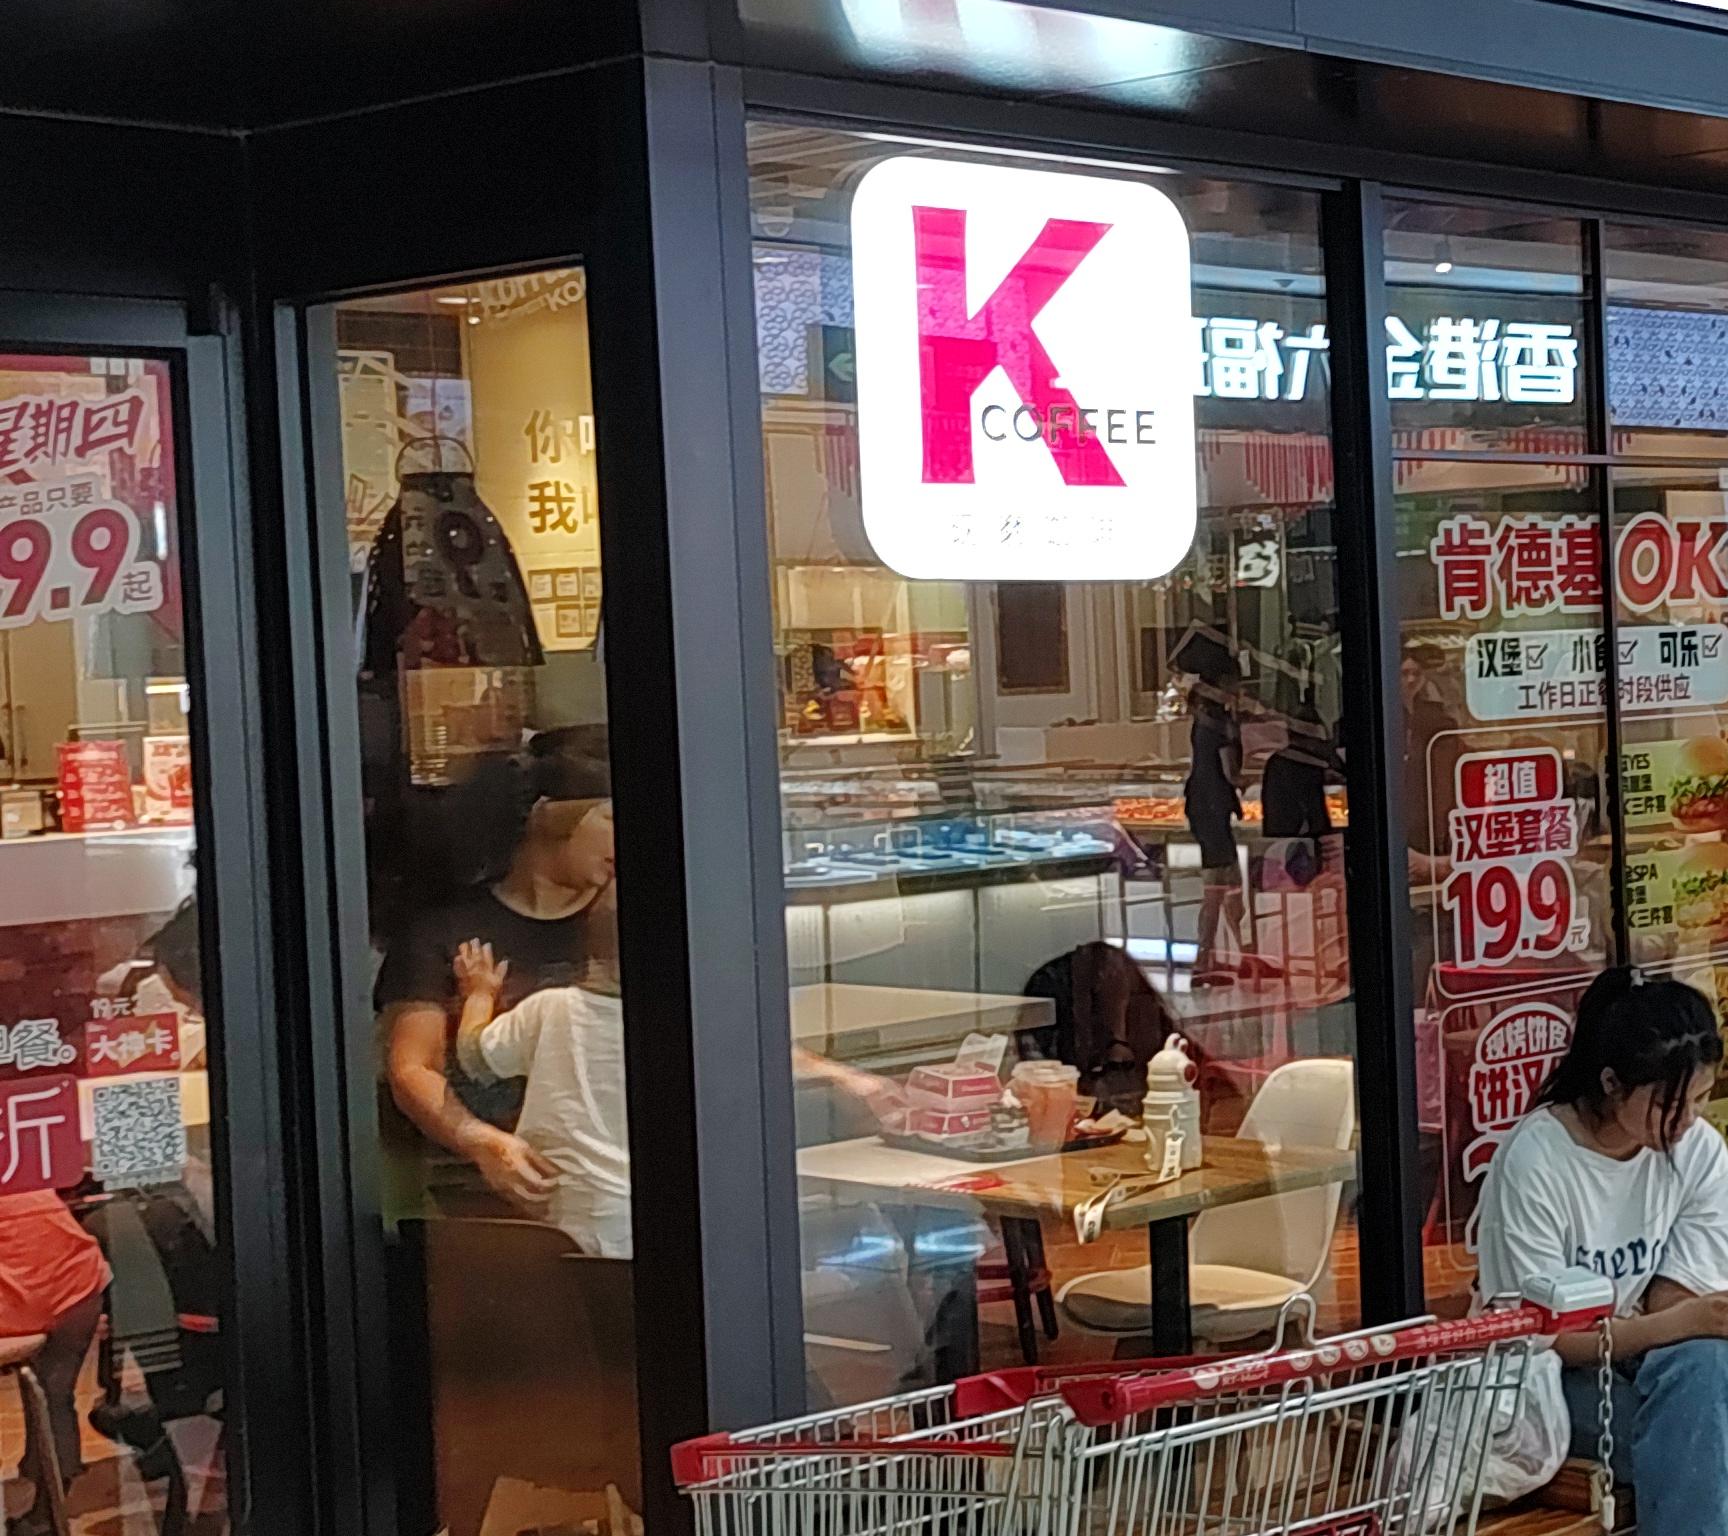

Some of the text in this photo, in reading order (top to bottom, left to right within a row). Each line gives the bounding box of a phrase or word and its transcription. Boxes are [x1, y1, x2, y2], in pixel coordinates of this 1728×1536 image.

[912, 205, 1127, 487] K
[981, 404, 1156, 444] COFFEE
[528, 479, 592, 534] 我
[122, 571, 153, 603] 起
[1436, 522, 1603, 613] 肯德基
[1619, 519, 1728, 606] OK
[1477, 638, 1524, 678] 汉堡
[1659, 631, 1700, 668] 可乐
[1484, 761, 1538, 802] 超值
[1454, 805, 1572, 862] 汉堡套餐
[1448, 859, 1572, 963] 19.9
